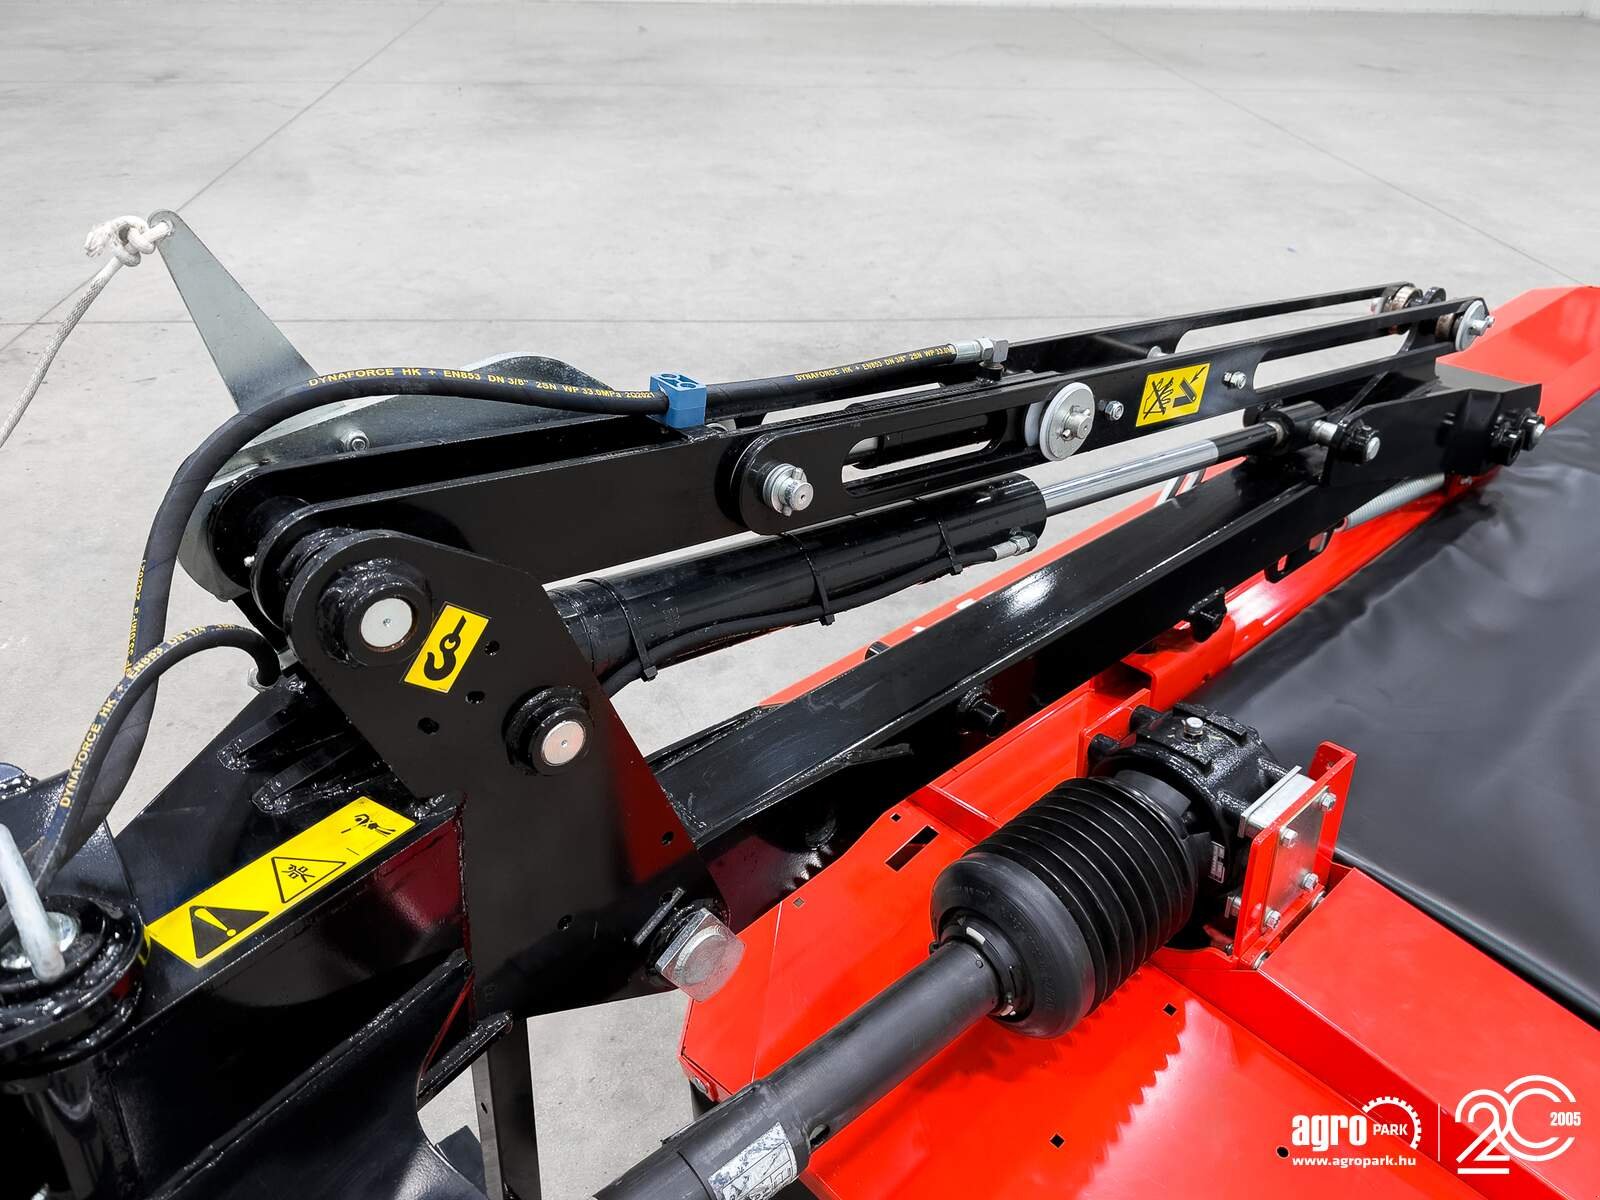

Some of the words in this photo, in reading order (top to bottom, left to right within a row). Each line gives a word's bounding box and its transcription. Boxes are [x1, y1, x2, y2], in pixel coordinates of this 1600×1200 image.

[308, 368, 395, 387] DYNAFORCE
[402, 368, 422, 376] HK
[443, 370, 481, 380] EN853
[487, 375, 505, 384] DN
[536, 381, 557, 391] 2SN
[562, 384, 579, 393] WP
[582, 388, 622, 398] 33.0MPa
[795, 370, 839, 382] DYNAFORCE
[59, 722, 102, 808] DYNAFORCE
[99, 697, 117, 717] HK
[125, 645, 164, 679] EN853
